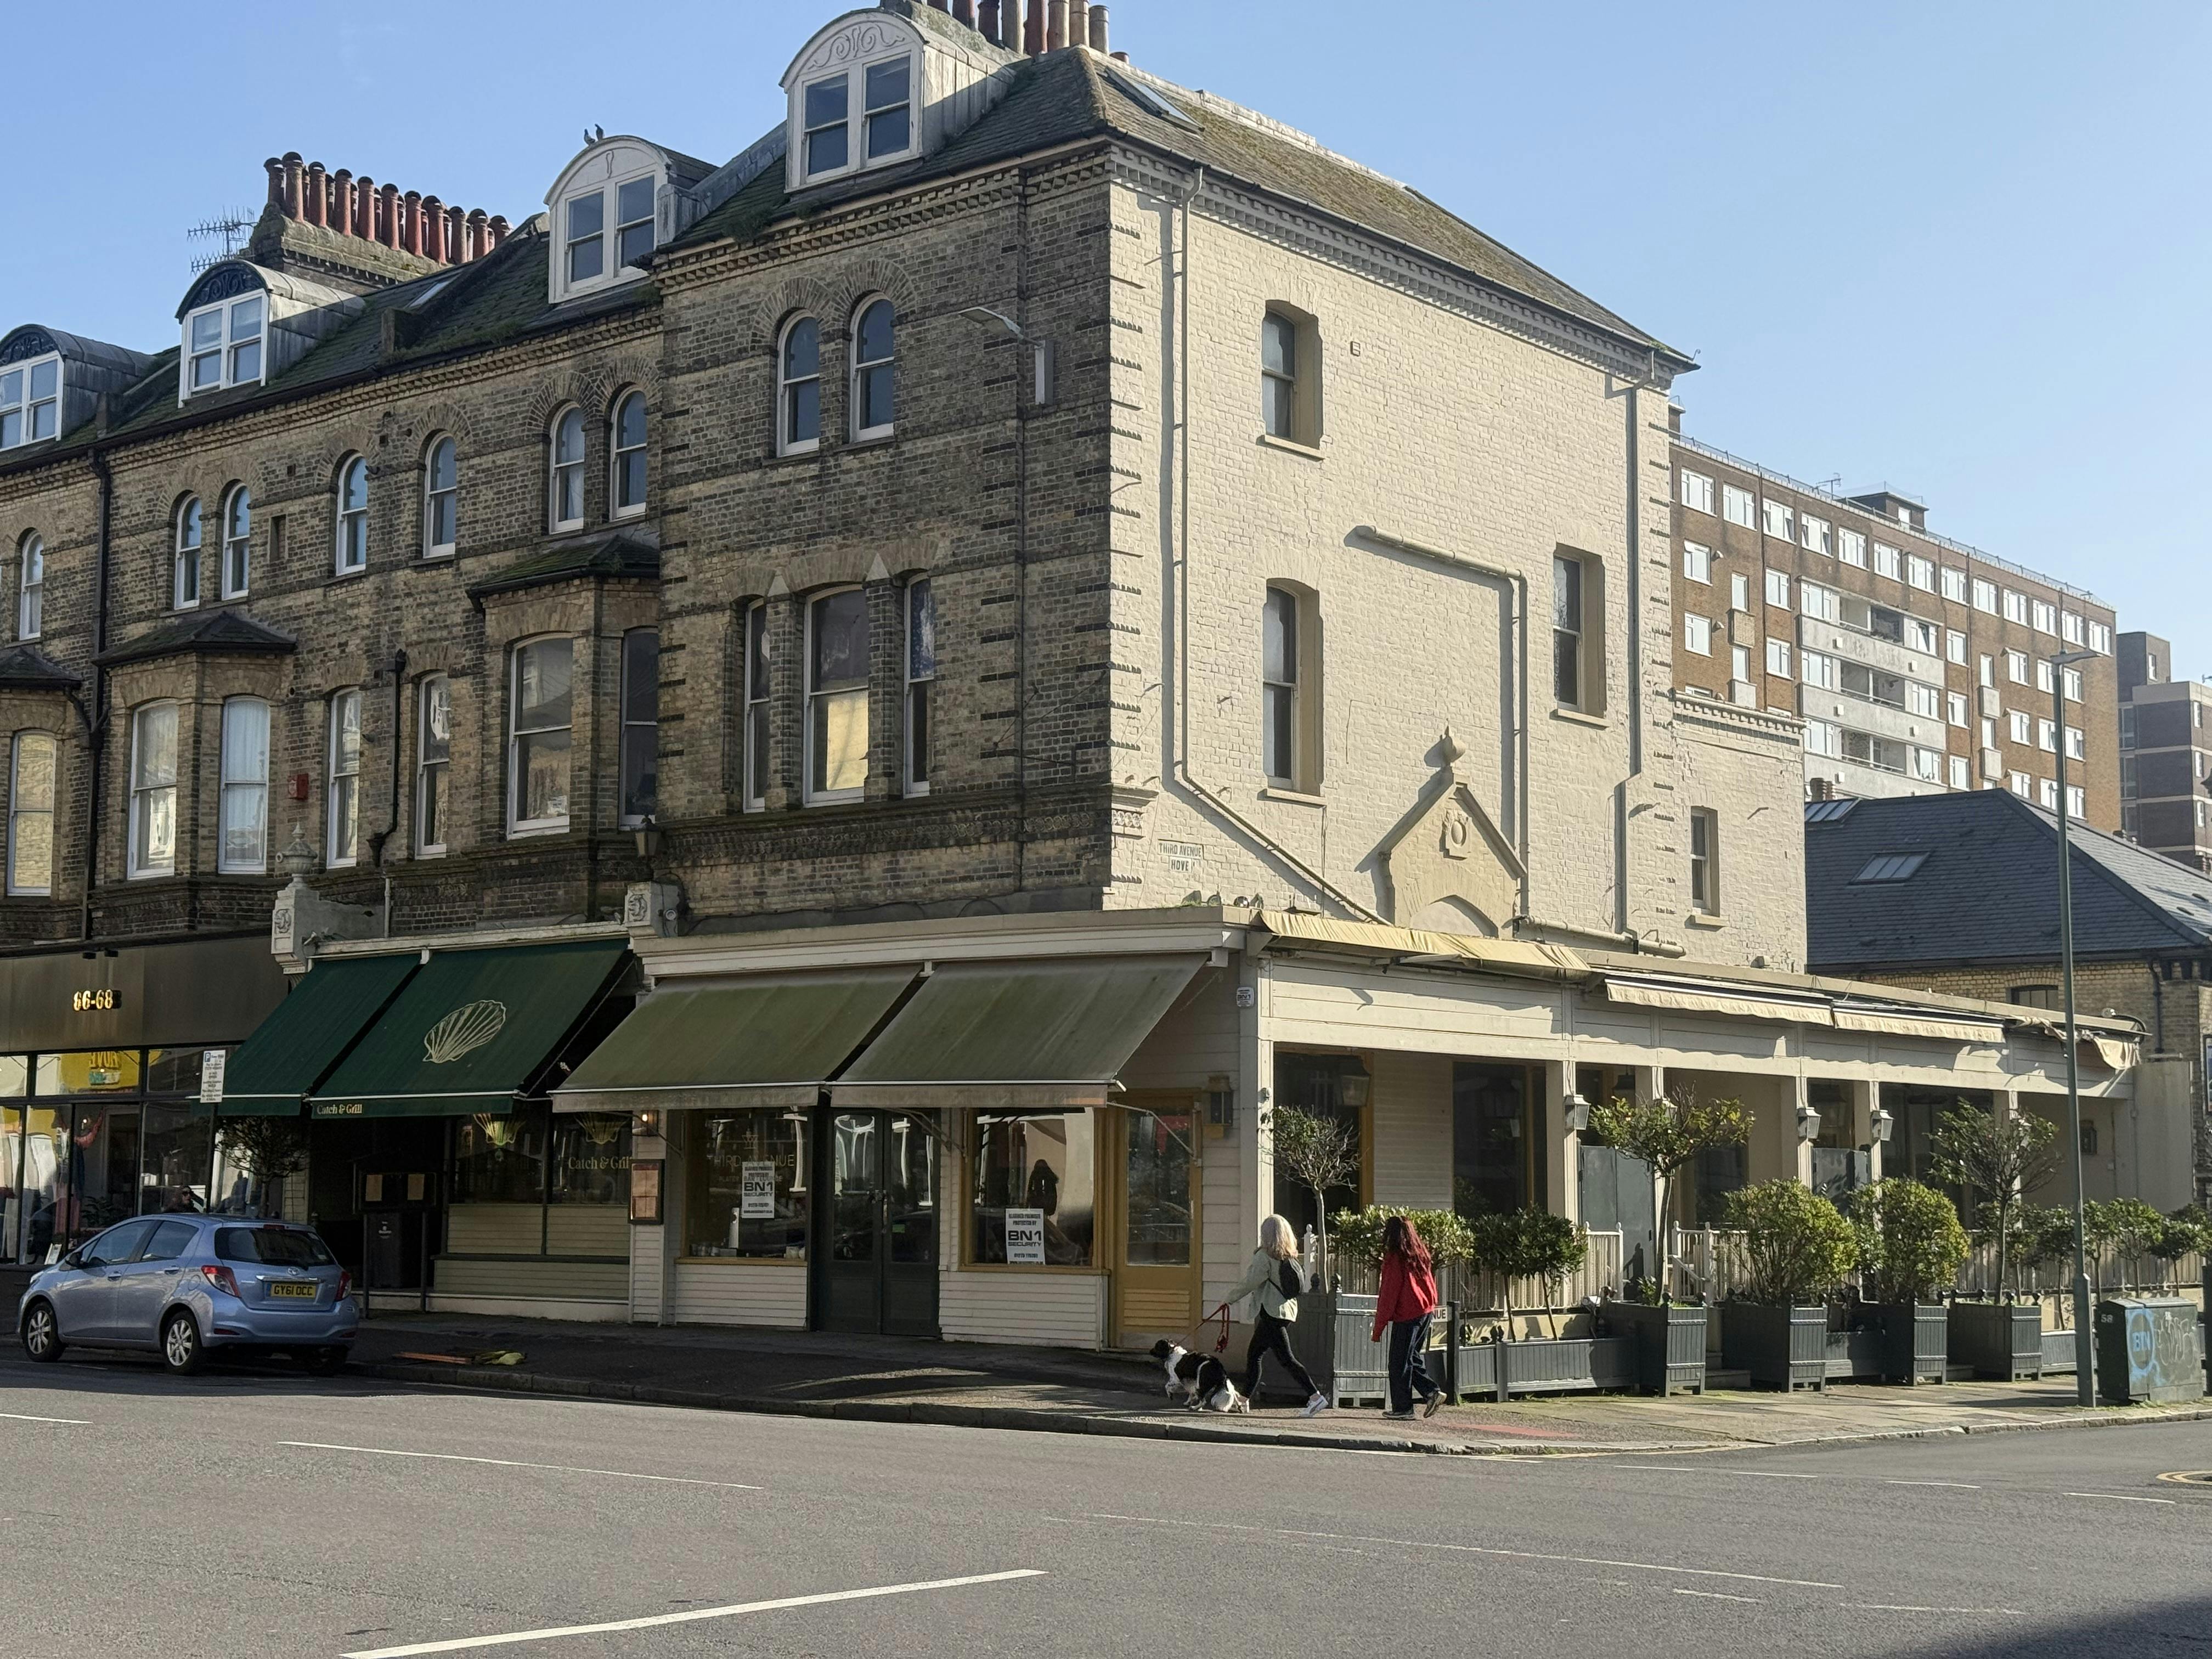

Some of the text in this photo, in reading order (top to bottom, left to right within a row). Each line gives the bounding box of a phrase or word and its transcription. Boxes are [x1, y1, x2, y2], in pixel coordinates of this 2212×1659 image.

[1159, 843, 1201, 857] THIRD AVENUE
[1171, 859, 1189, 871] HOVE
[317, 1104, 338, 1115] Catch
[346, 1103, 363, 1114] Grill
[568, 1156, 632, 1170] Catch & Gril
[744, 1182, 773, 1191] BN1
[1008, 1230, 1041, 1241] BN1
[274, 1285, 295, 1295] GY61
[1432, 1309, 1446, 1319] NUE
